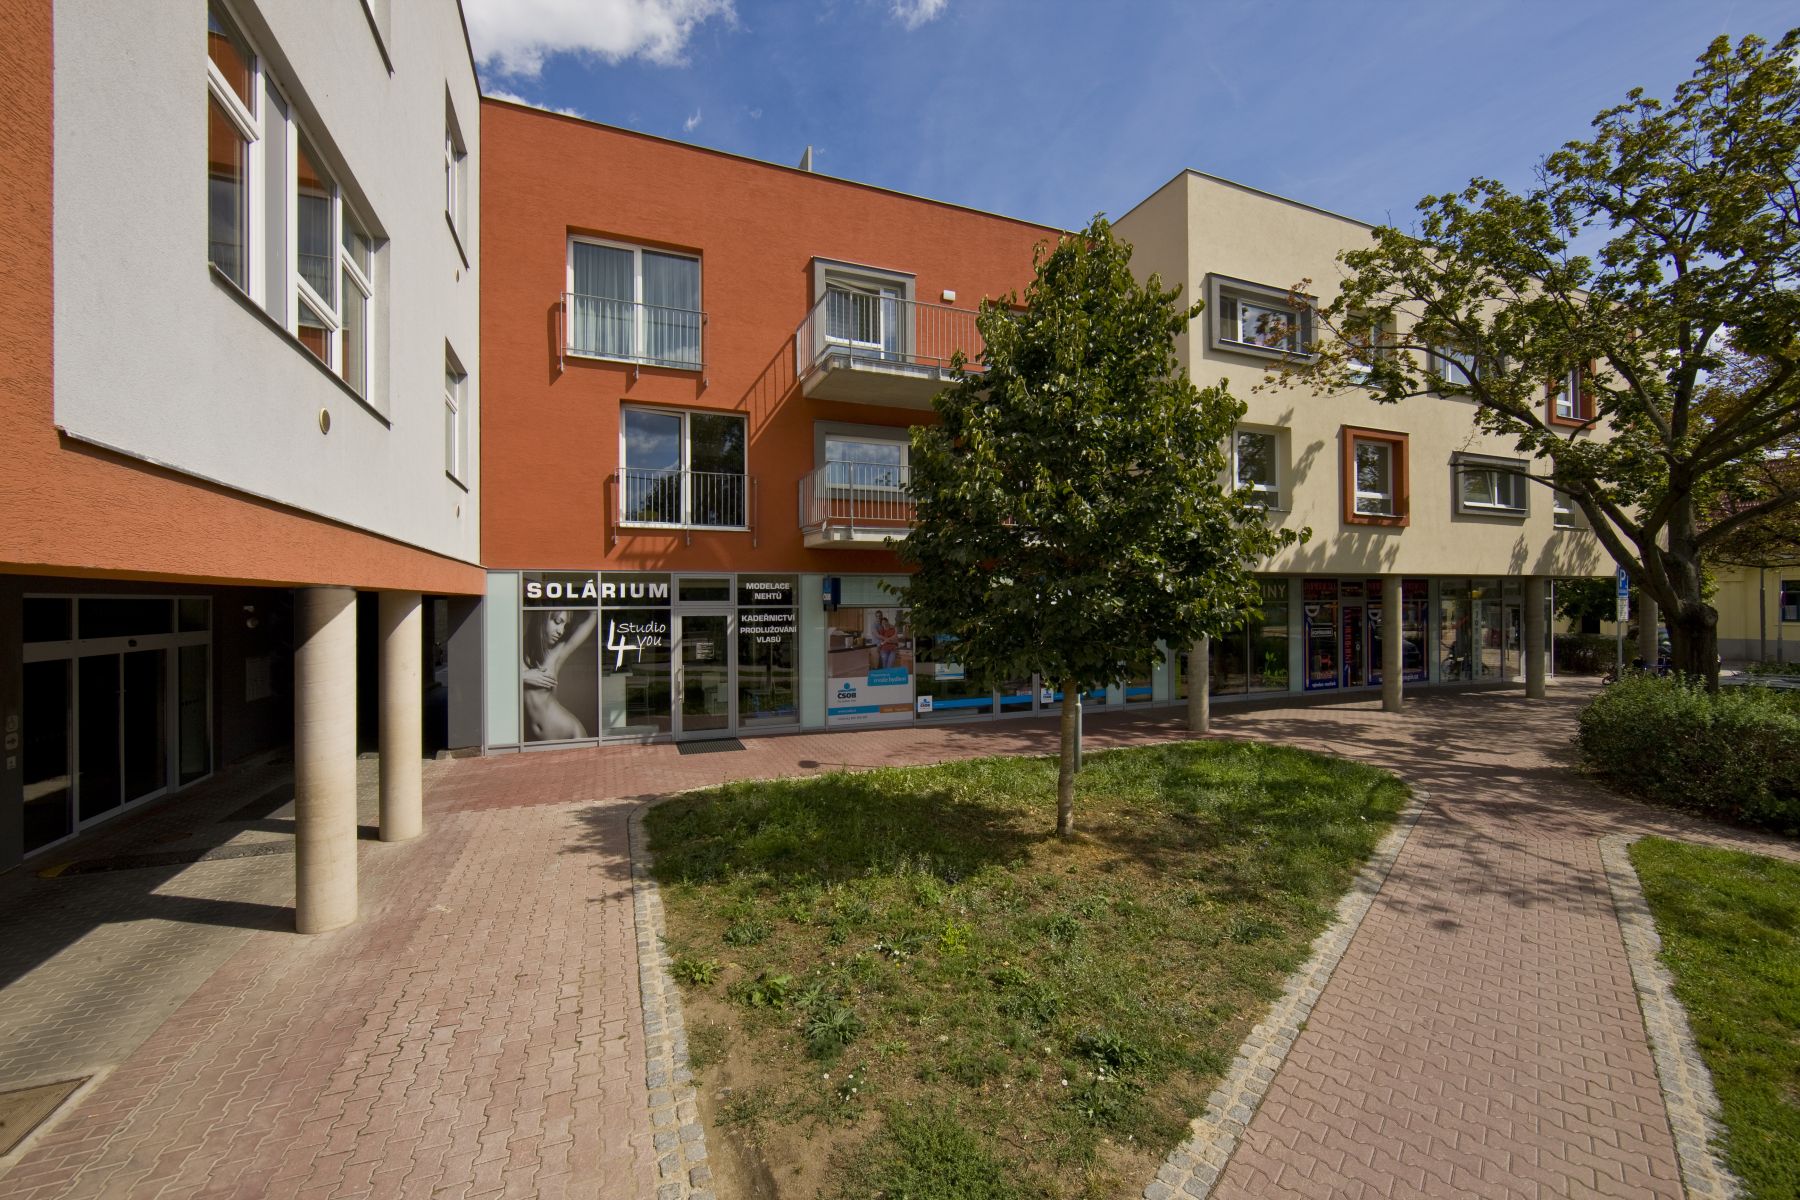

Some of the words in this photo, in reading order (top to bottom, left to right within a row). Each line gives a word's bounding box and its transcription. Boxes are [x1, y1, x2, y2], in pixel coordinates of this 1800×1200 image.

[527, 579, 668, 598] SOLÁRIUM
[746, 582, 790, 590] MODELACE
[754, 591, 782, 600] NEHTŮ
[741, 613, 796, 622] KADEŘNICTVÍ
[617, 620, 666, 633] Studio
[740, 625, 797, 634] PRODLUŽOVÁNÍ
[756, 634, 782, 643] VLASŮ
[607, 619, 645, 671] 4
